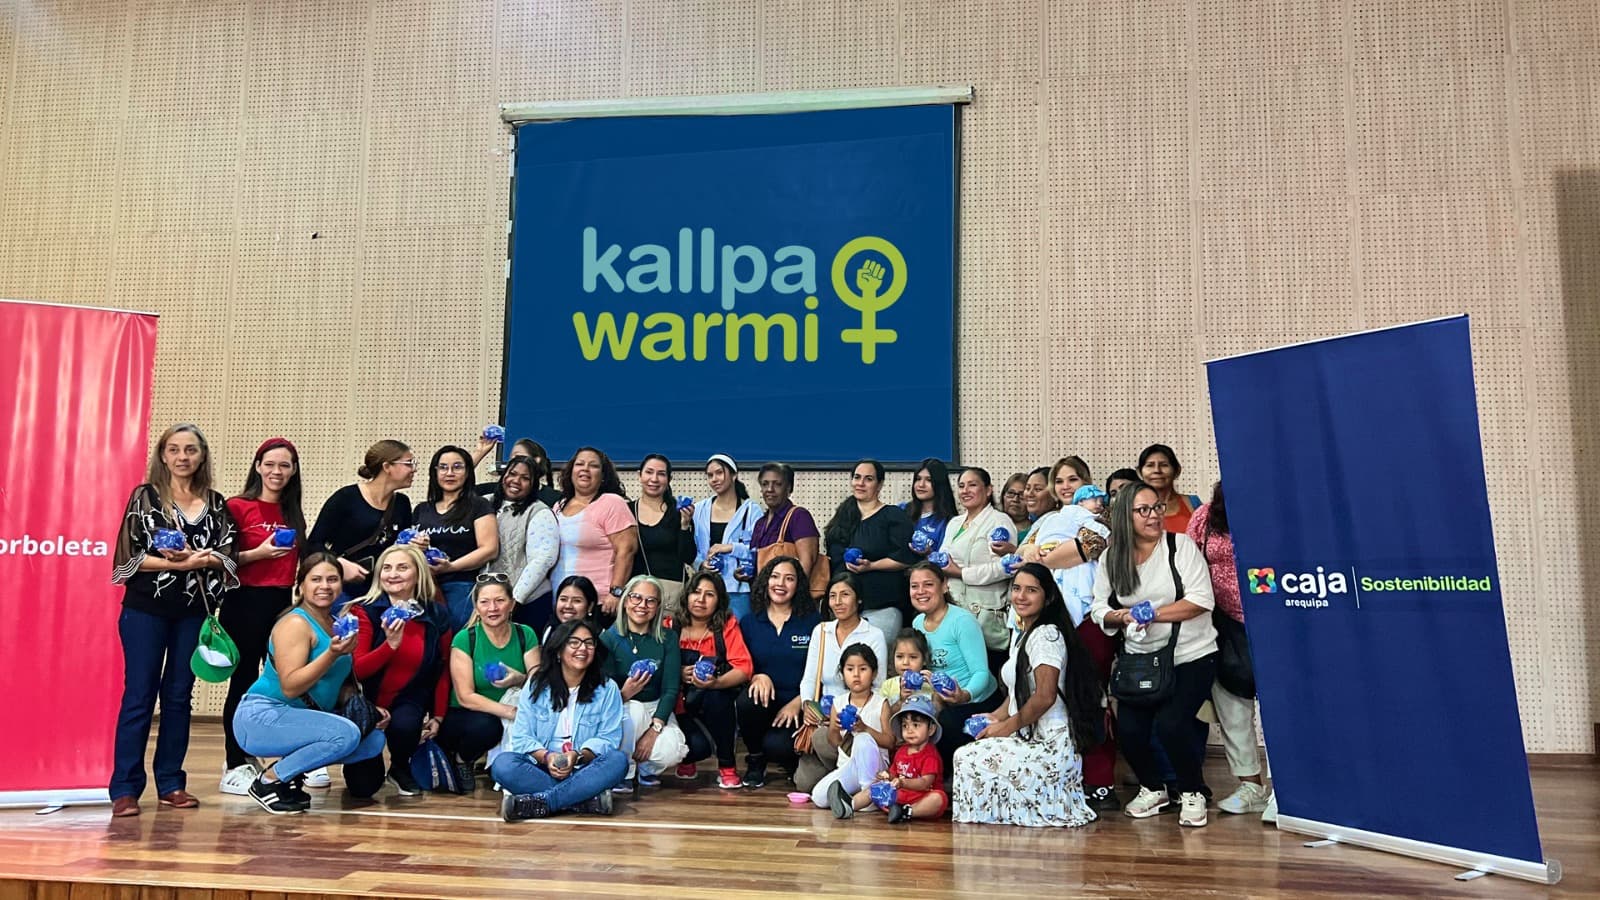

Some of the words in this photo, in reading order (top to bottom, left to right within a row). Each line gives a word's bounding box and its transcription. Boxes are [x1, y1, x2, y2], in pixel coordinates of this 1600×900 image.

[582, 226, 817, 310] kallpa
[572, 296, 819, 362] warmi
[1281, 566, 1348, 598] caja
[1361, 576, 1492, 592] Sostenibilidad
[1285, 598, 1329, 609] arequipa
